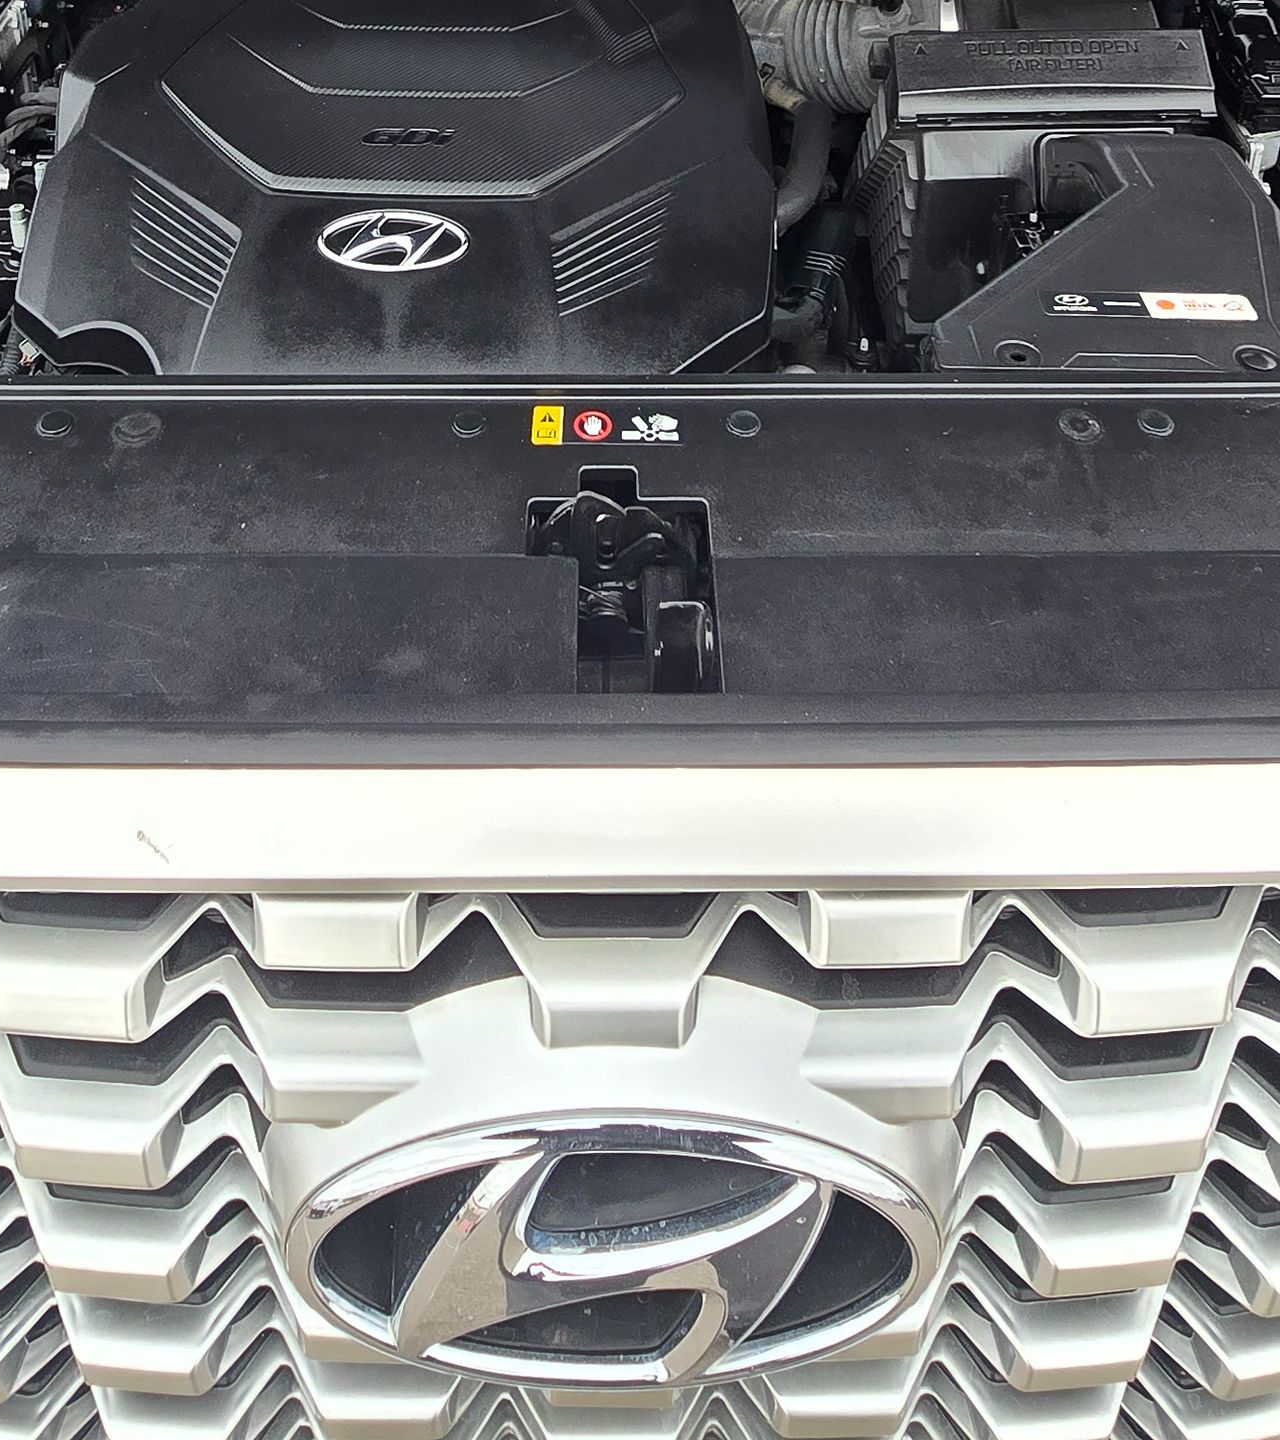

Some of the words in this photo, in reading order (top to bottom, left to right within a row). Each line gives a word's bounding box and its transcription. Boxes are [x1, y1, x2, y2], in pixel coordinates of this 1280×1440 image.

[963, 40, 1014, 55] PULL
[1017, 39, 1054, 54] OUT
[1057, 39, 1084, 54] TO
[1087, 39, 1141, 54] OPEN
